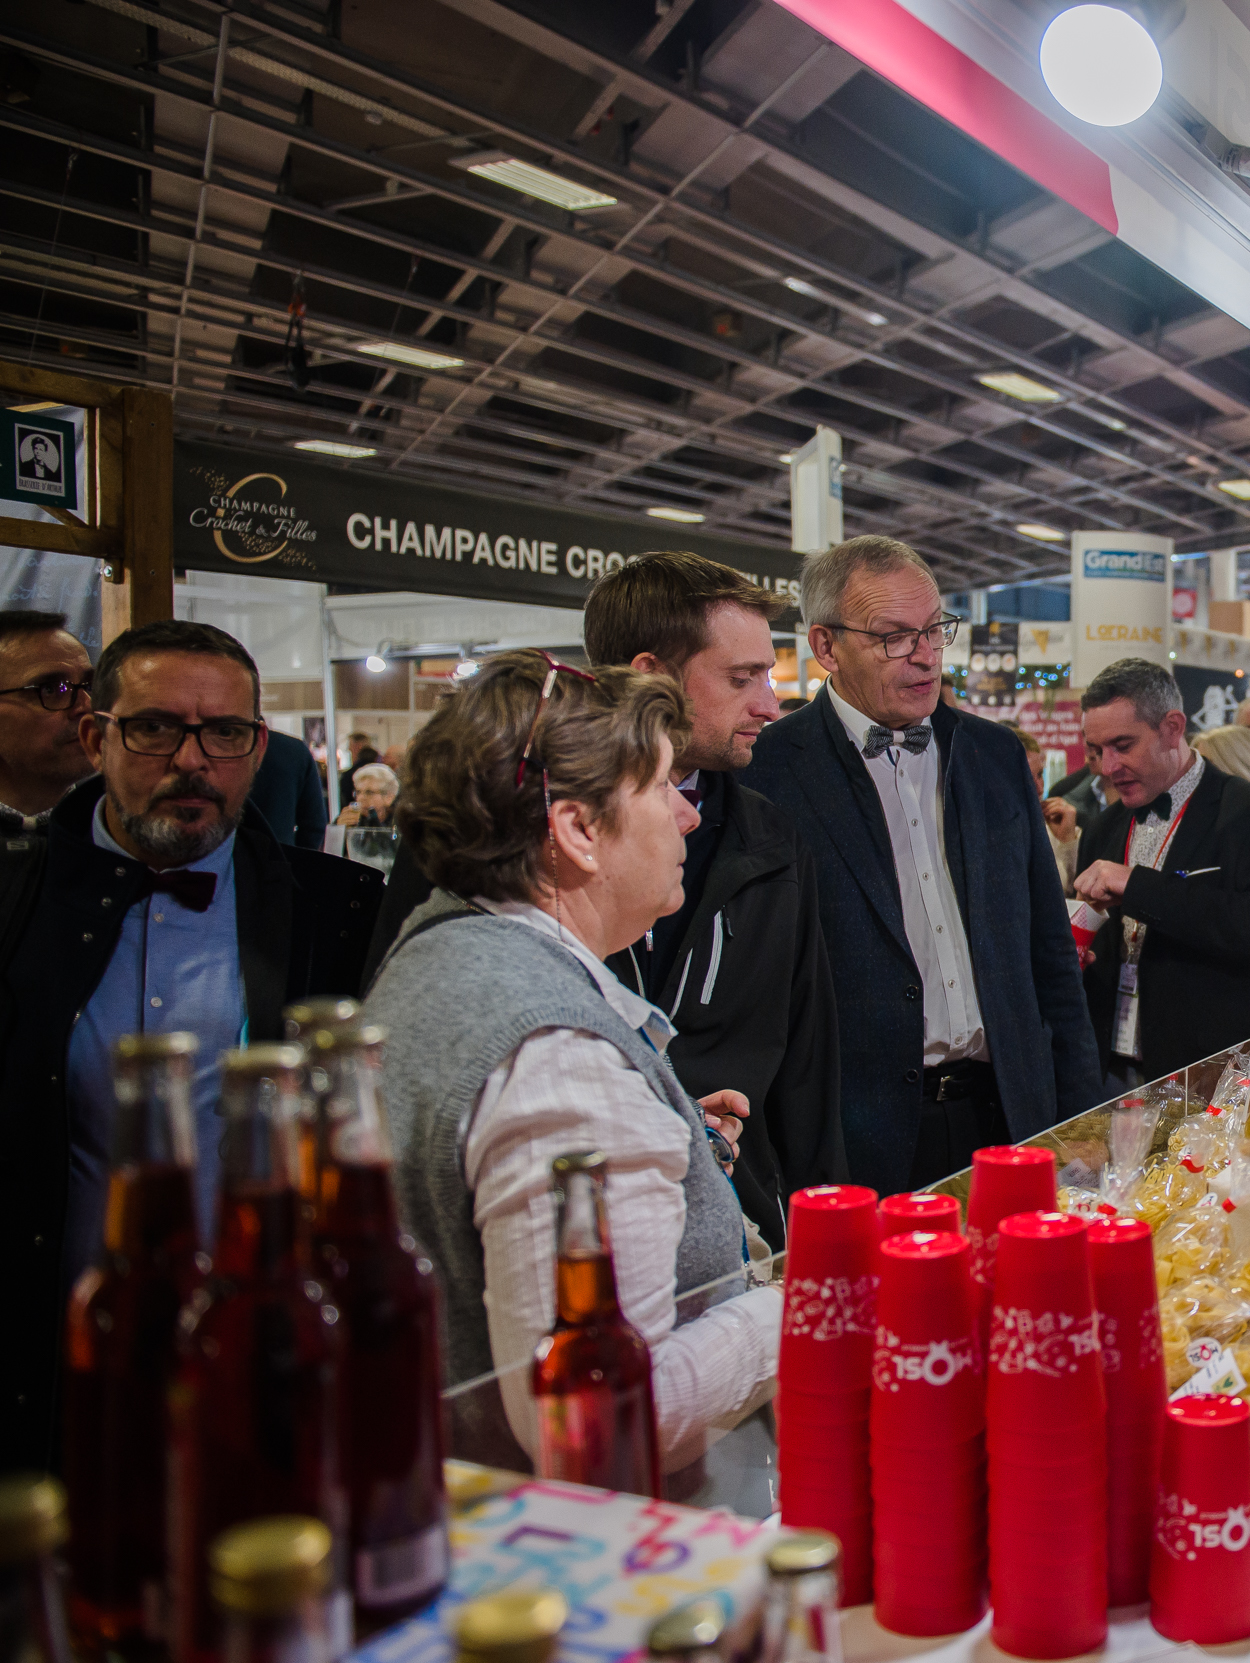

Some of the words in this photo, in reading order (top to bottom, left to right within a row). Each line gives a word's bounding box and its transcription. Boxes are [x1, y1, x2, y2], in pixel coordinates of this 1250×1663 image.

[209, 495, 297, 518] CHAMPAGNE
[189, 507, 253, 533] Crochet
[270, 517, 318, 542] Filles
[346, 512, 559, 575] CHAMPAGNE
